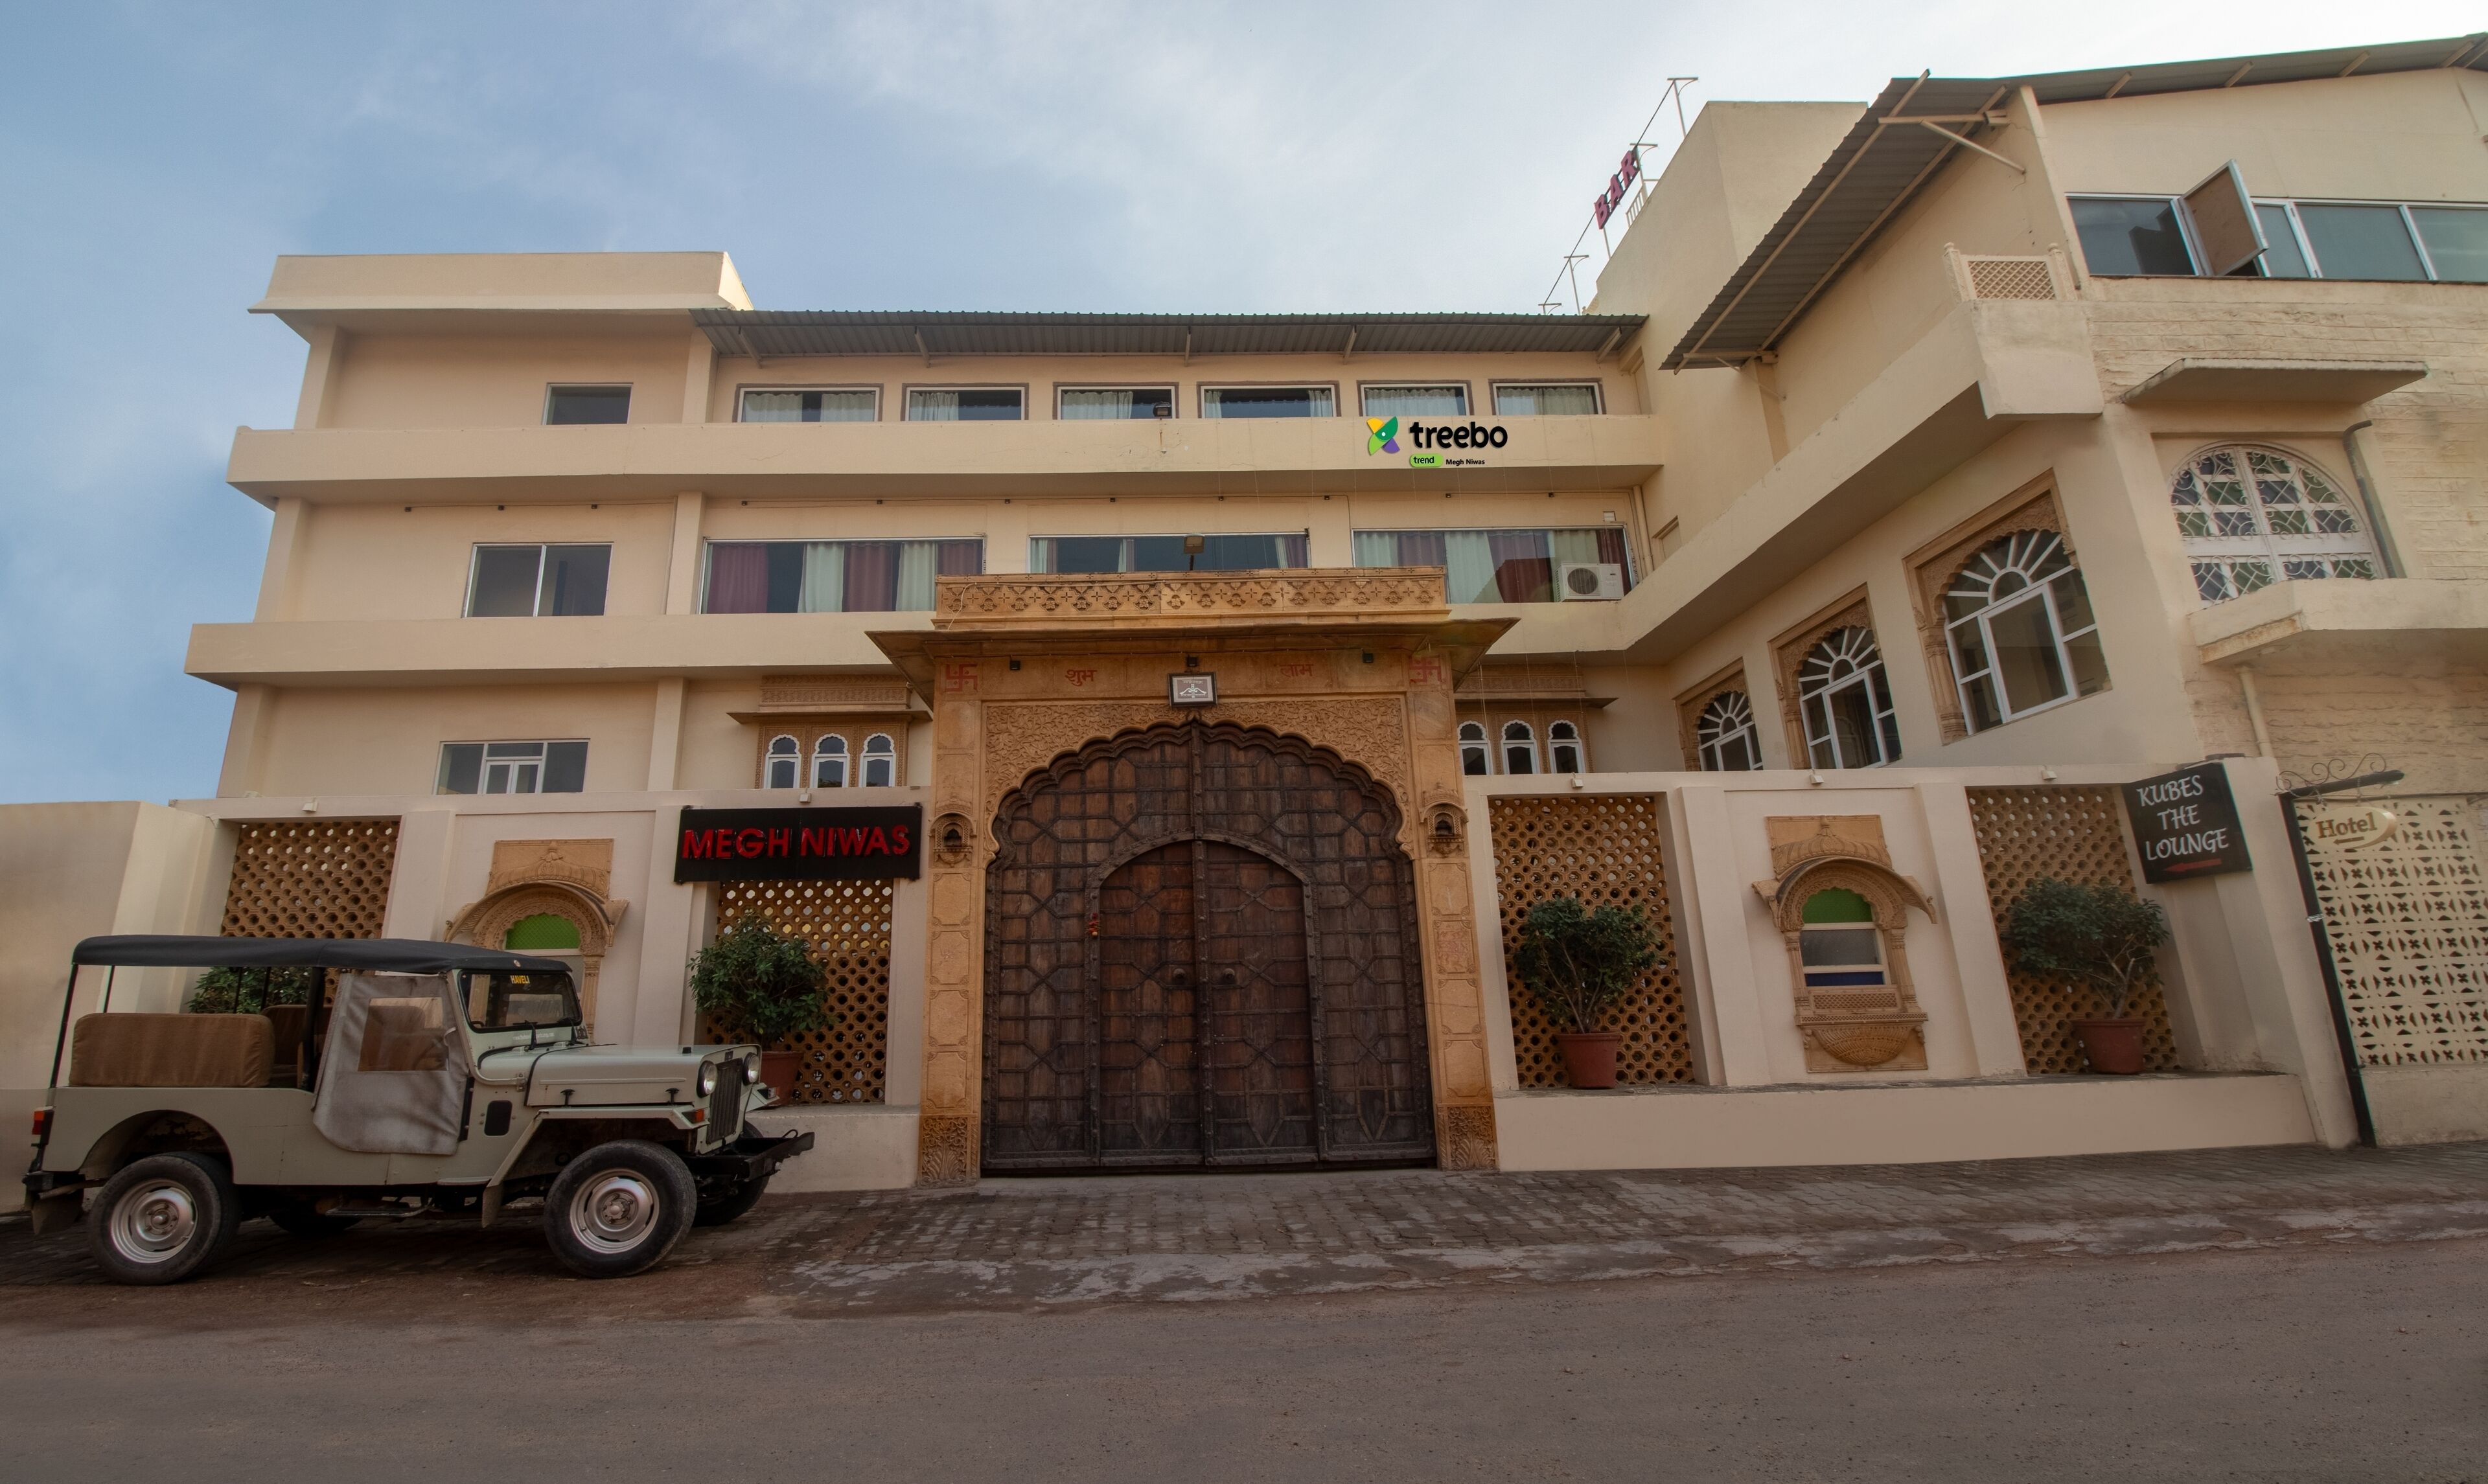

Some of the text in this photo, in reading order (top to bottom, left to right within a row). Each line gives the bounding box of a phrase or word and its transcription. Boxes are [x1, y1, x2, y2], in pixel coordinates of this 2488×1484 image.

[1595, 150, 1640, 229] BAR
[1409, 422, 1508, 448] treebo
[1413, 456, 1434, 464] trend
[1065, 669, 1098, 687] शुभ
[2136, 775, 2203, 806] KUBES
[2157, 804, 2200, 831] THE
[2316, 812, 2377, 839] Hotel
[682, 825, 912, 859] MEGH NIWAS
[2146, 828, 2229, 861] LOUNGE
[510, 975, 531, 985] HAVELI
